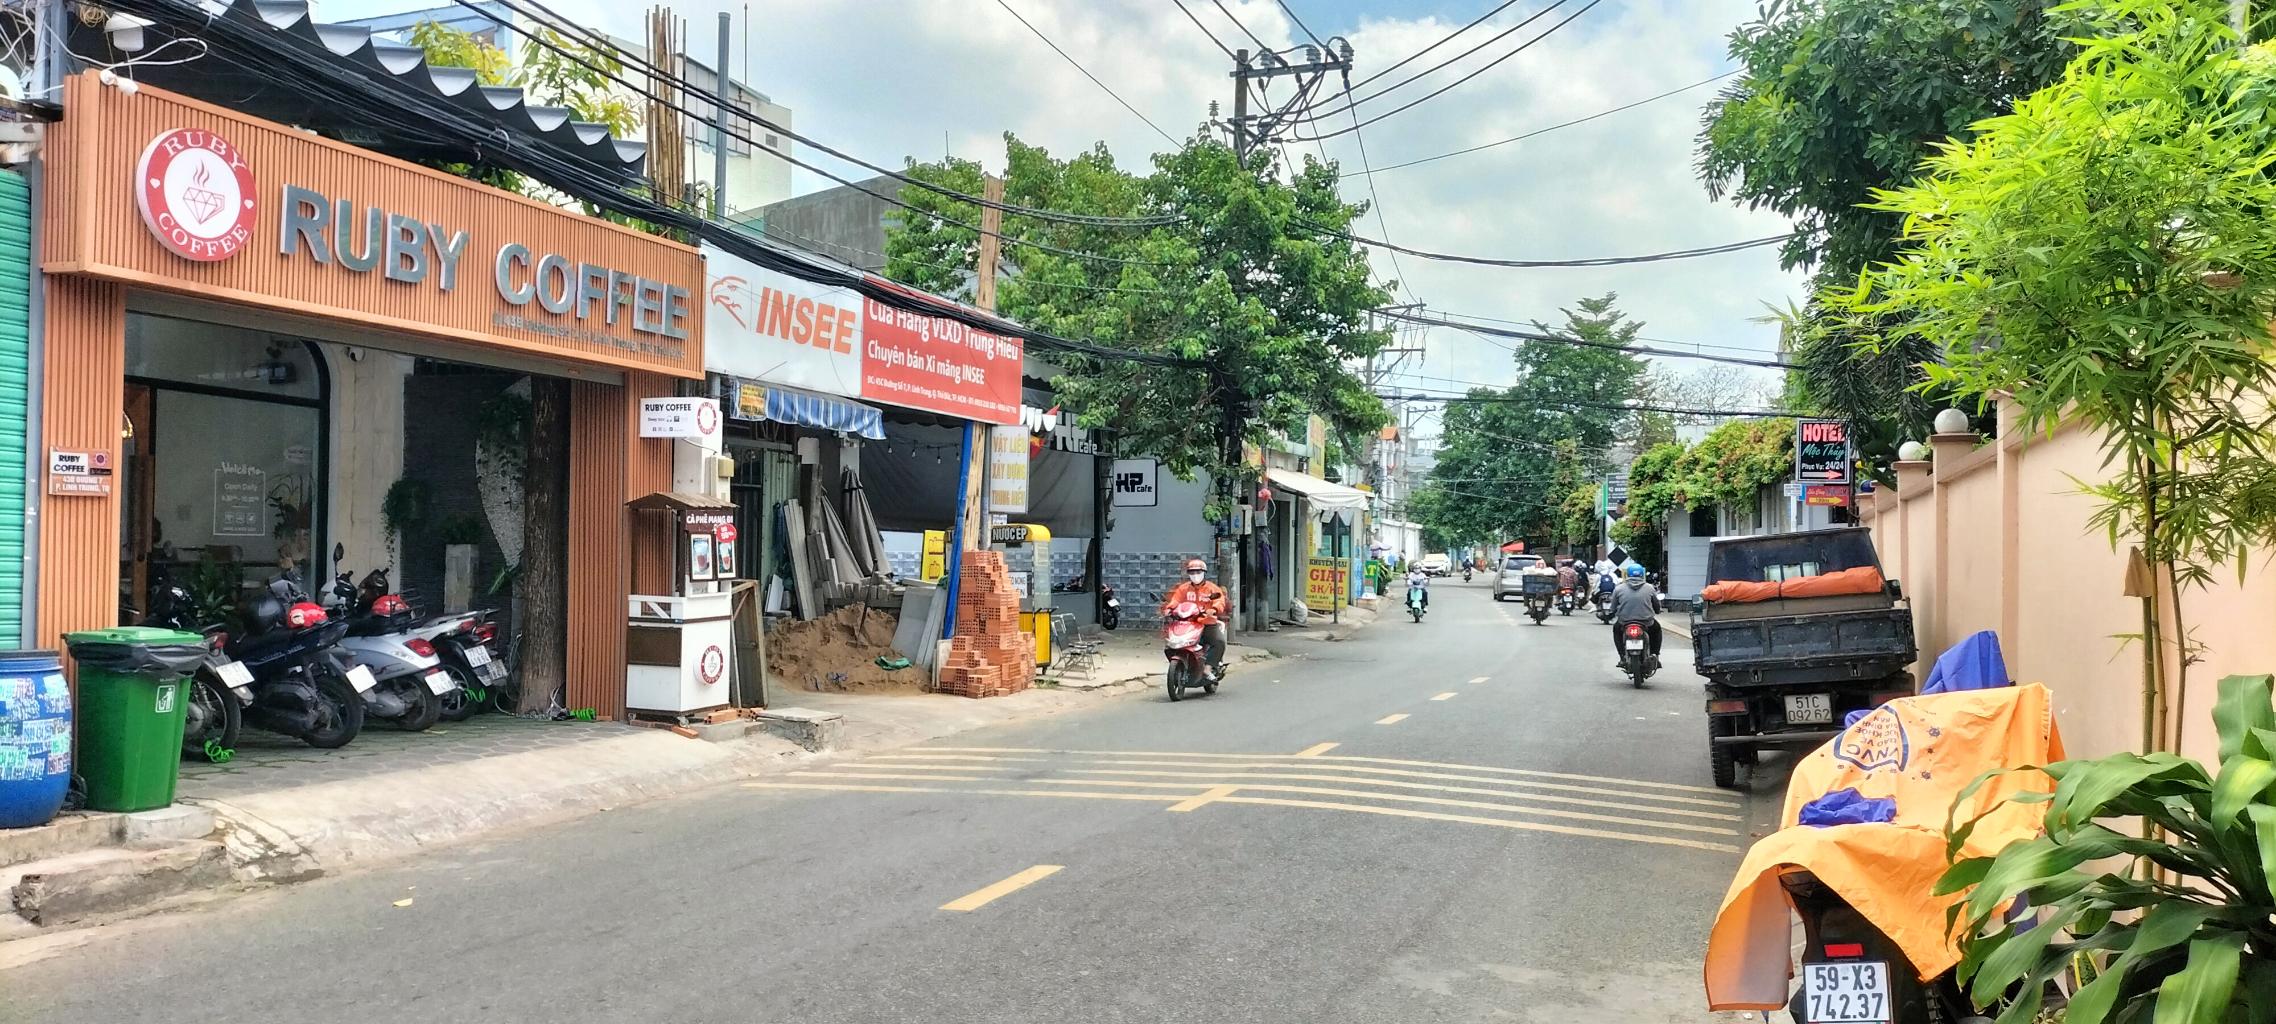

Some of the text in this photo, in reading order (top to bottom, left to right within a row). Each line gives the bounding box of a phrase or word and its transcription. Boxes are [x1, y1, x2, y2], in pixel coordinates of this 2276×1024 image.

[161, 131, 248, 172] RUBY
[158, 212, 249, 257] COFFEE
[279, 183, 690, 341] RUBY COFFEE
[756, 286, 856, 354] INSEE
[932, 317, 962, 345] VLXD
[963, 324, 996, 361] Trung
[868, 339, 986, 385] Chuyên bán Xi măng INSEE
[645, 403, 692, 412] RUBY COFFEE
[1802, 423, 1846, 442] HOTEL
[1080, 439, 1098, 455] cafe
[58, 454, 80, 463] RUBY
[1825, 461, 1844, 470] 24/24
[53, 464, 85, 473] COFFEE
[1136, 484, 1152, 493] cafe
[1015, 526, 1027, 541] ÉP
[1796, 696, 1820, 709] 51C
[1846, 744, 1898, 763] VNVC
[1815, 965, 1877, 992] 59-X3
[1811, 992, 1884, 1020] 742.37
